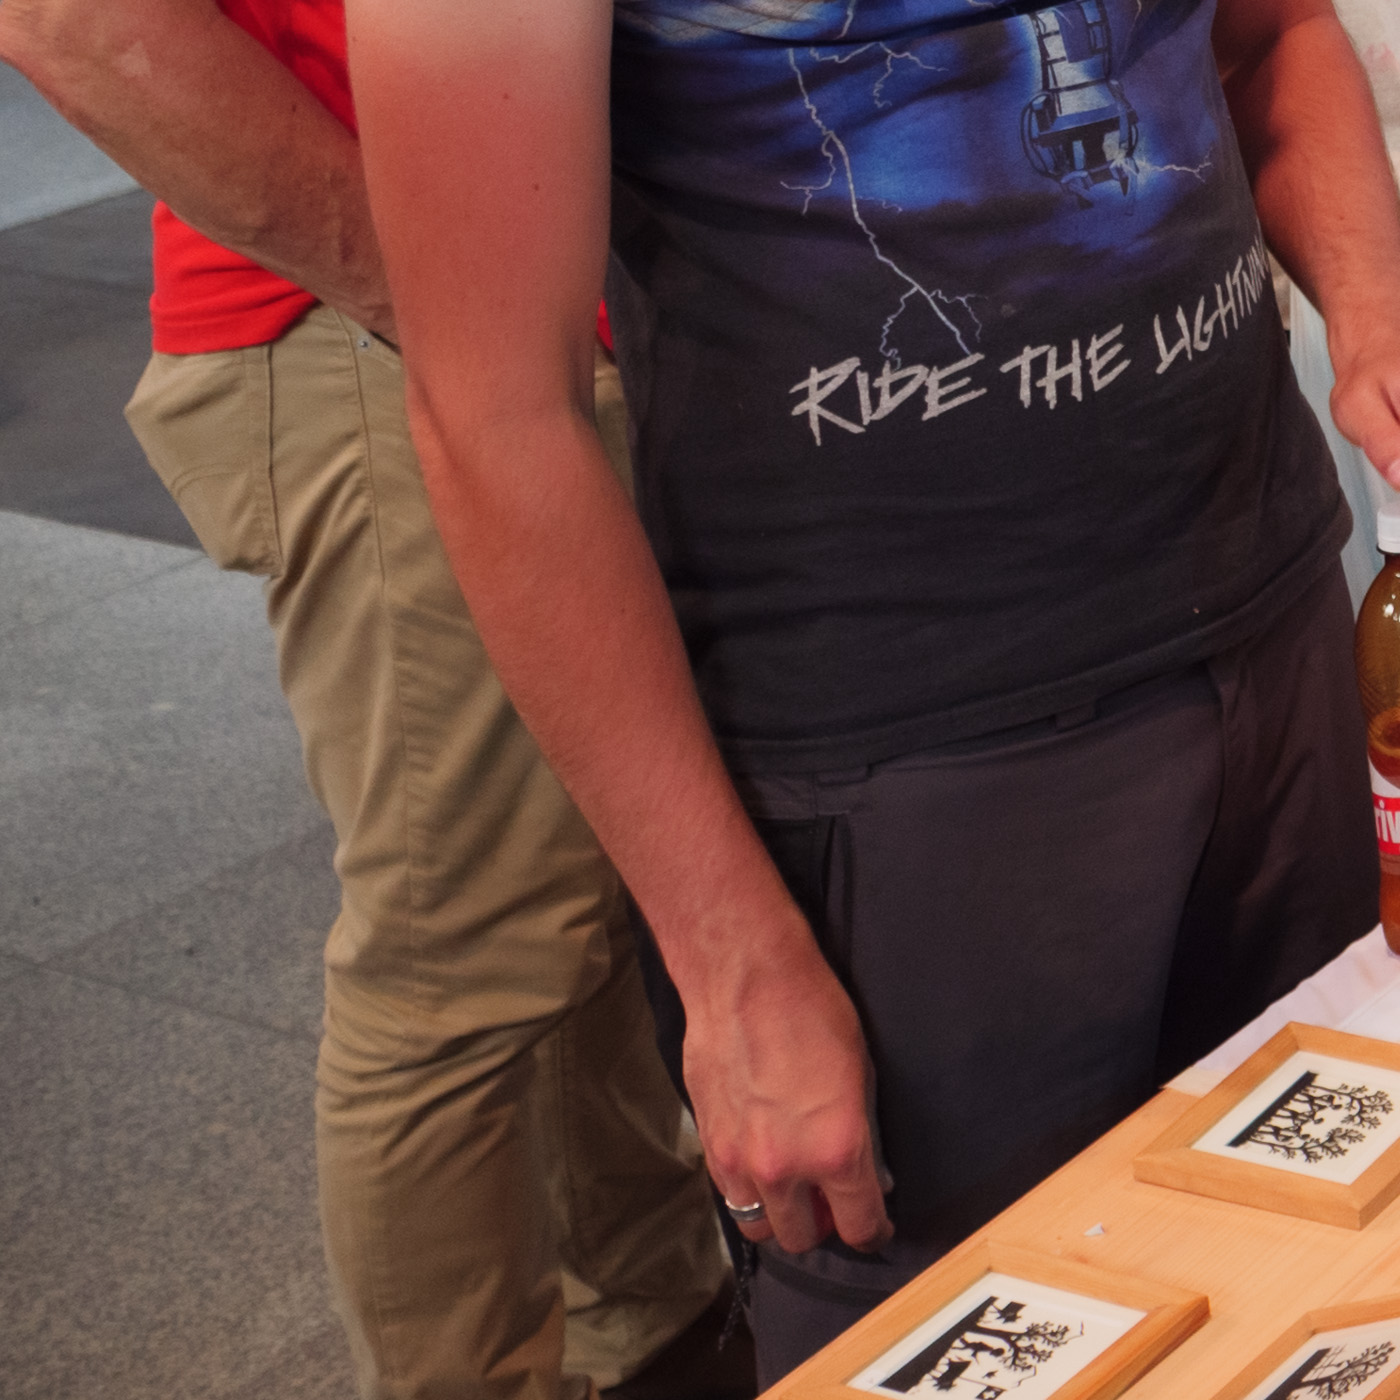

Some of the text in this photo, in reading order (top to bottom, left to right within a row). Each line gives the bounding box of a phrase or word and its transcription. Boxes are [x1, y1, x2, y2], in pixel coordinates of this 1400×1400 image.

[788, 226, 1269, 448] RIDE THE LIGHTNIN
